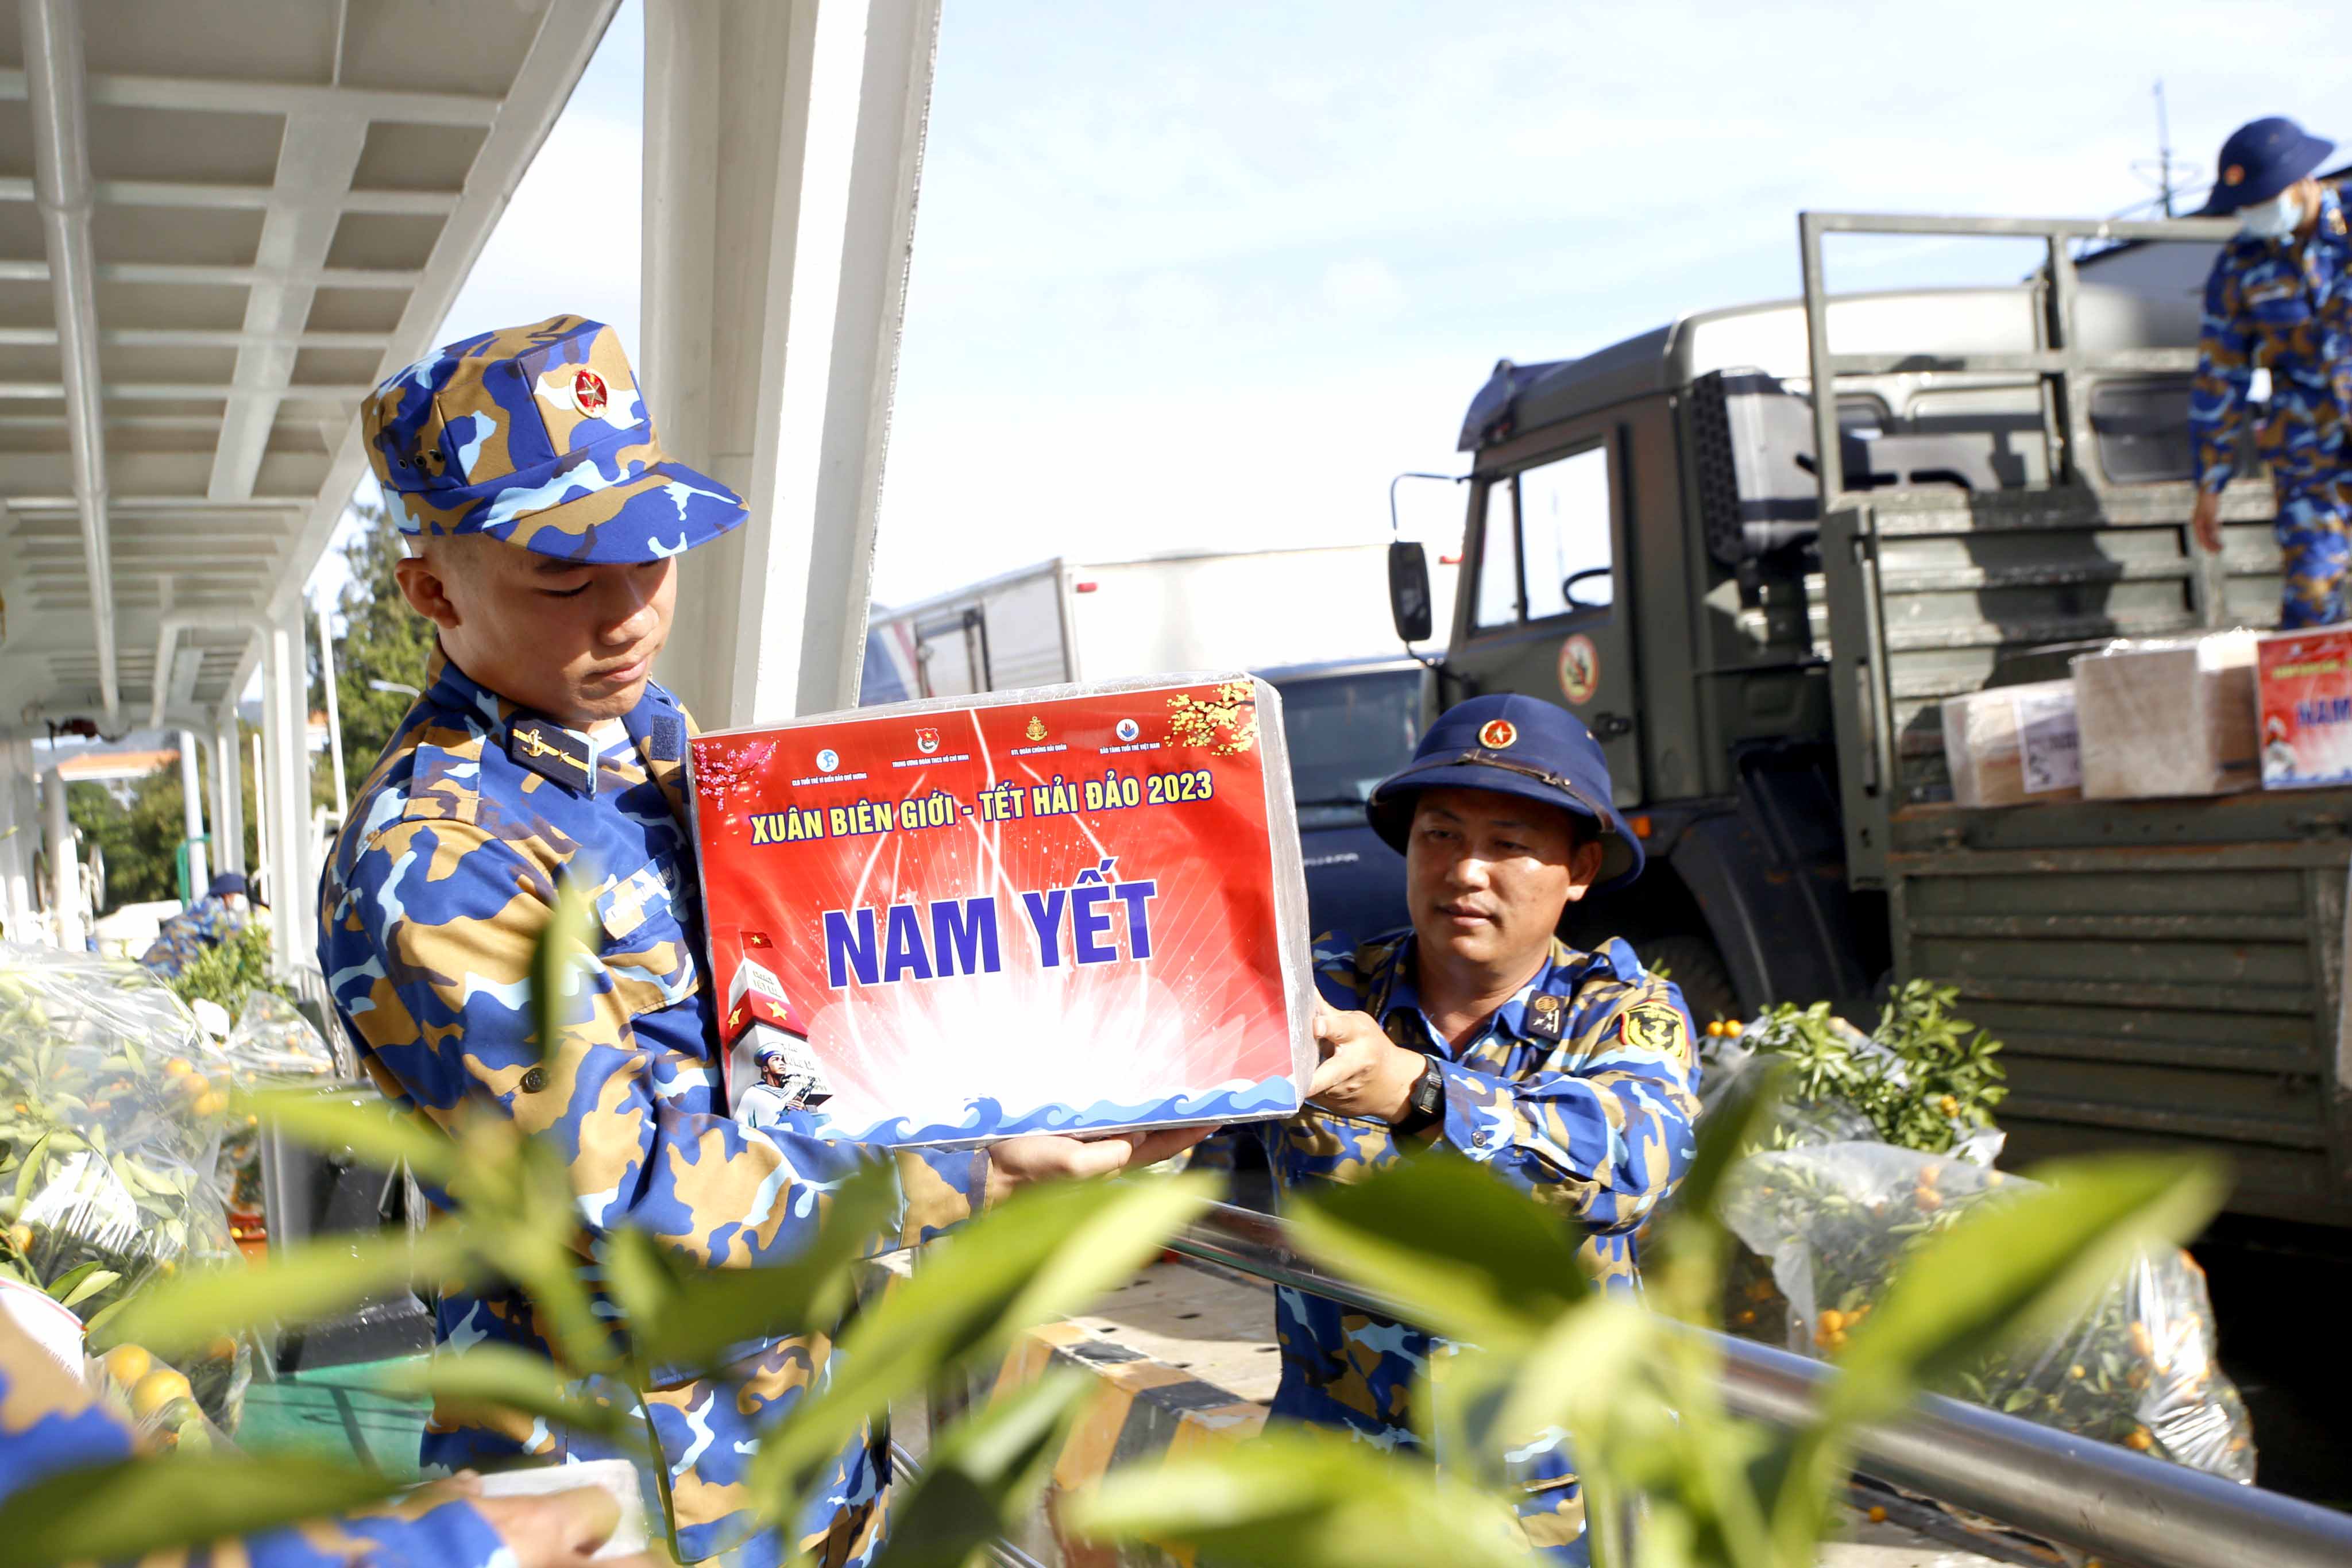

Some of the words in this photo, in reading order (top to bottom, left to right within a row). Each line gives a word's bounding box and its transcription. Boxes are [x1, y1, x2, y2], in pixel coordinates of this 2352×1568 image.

[1140, 743, 1149, 751] VIỆT
[750, 809, 825, 845] XUÂN
[831, 797, 894, 837] BIÊN
[900, 791, 956, 833] GIỚI
[979, 778, 1025, 822] TẾT
[1032, 774, 1080, 816] HẢI
[1086, 768, 1140, 811] ĐẢO
[1148, 770, 1214, 805] 2023
[823, 896, 1002, 989] NAM
[1021, 856, 1157, 970] YẾT
